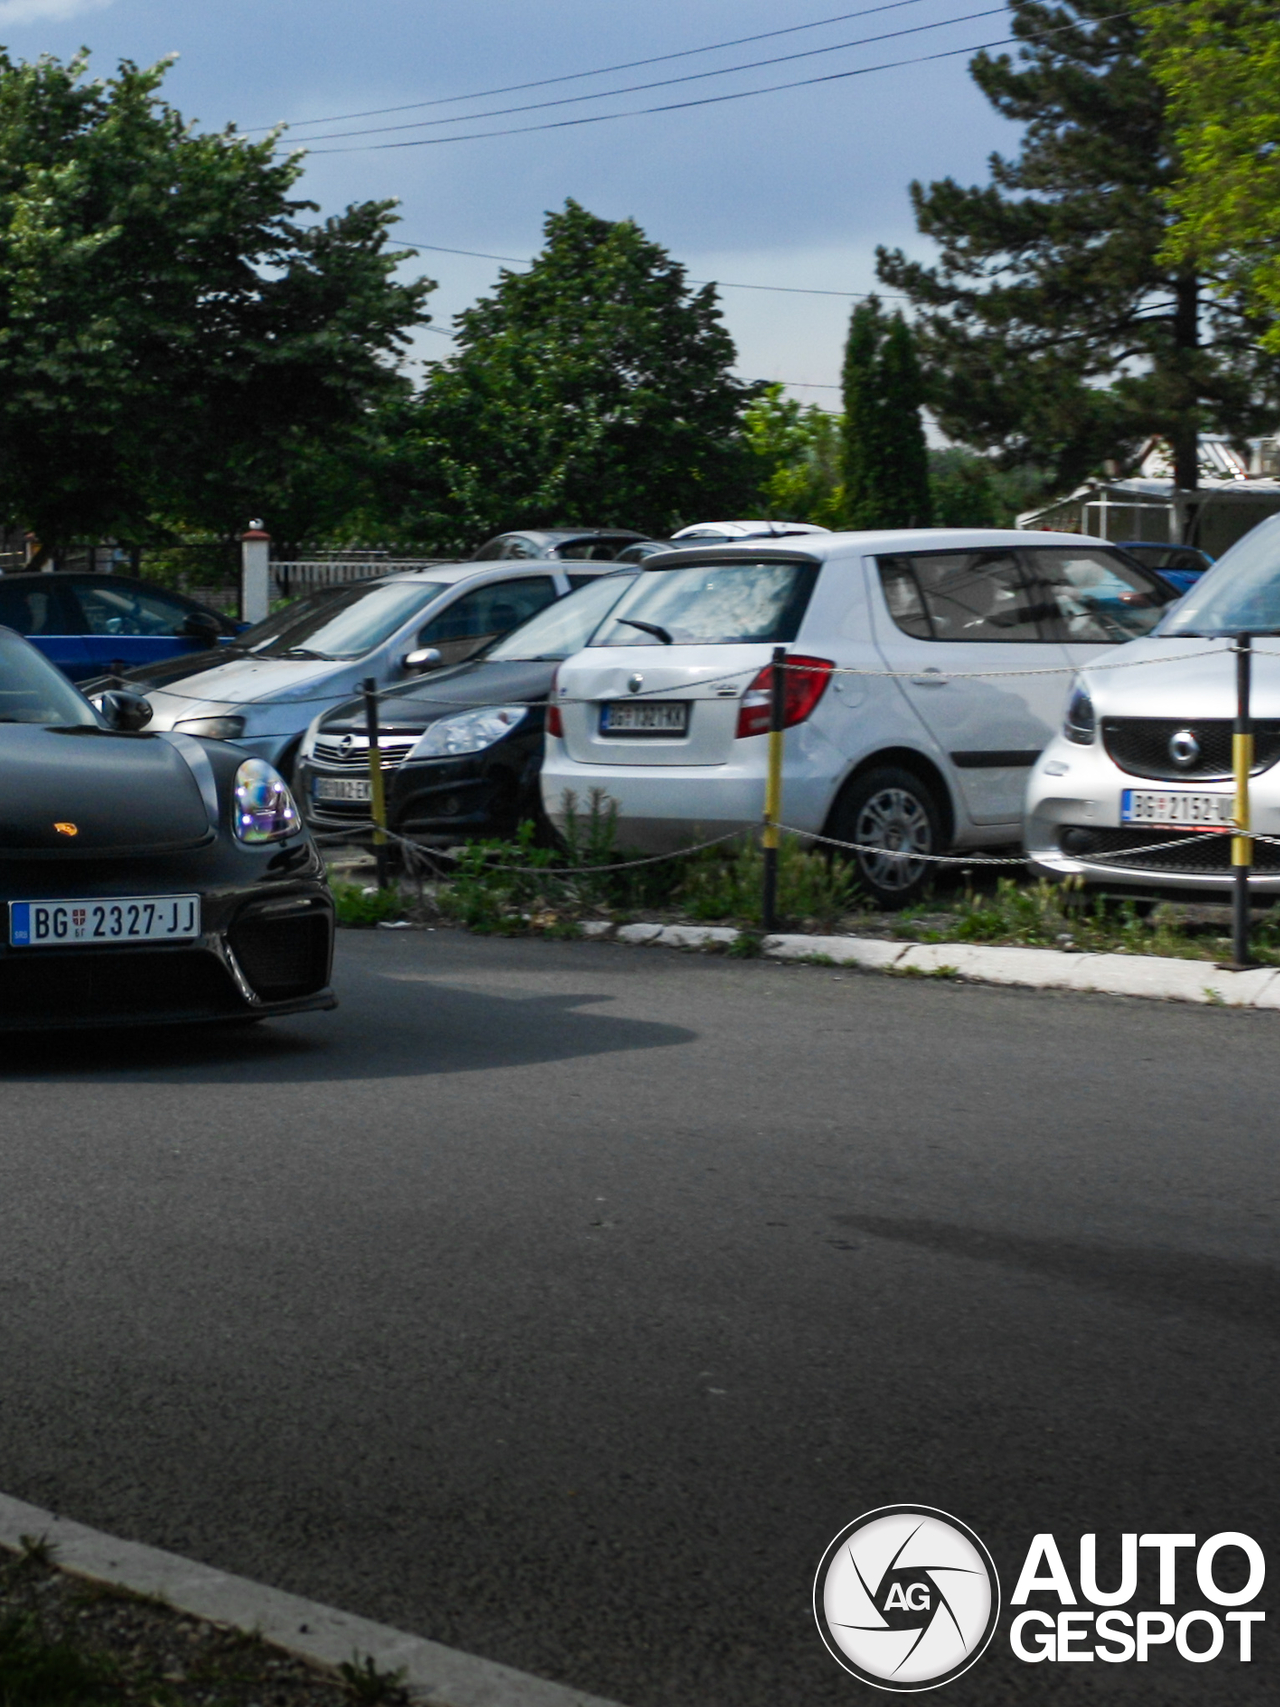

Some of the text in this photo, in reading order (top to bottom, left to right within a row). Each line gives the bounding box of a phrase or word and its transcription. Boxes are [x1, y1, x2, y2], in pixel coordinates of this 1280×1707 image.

[1134, 794, 1153, 818] BG
[35, 902, 194, 939] BG 2327-JJ
